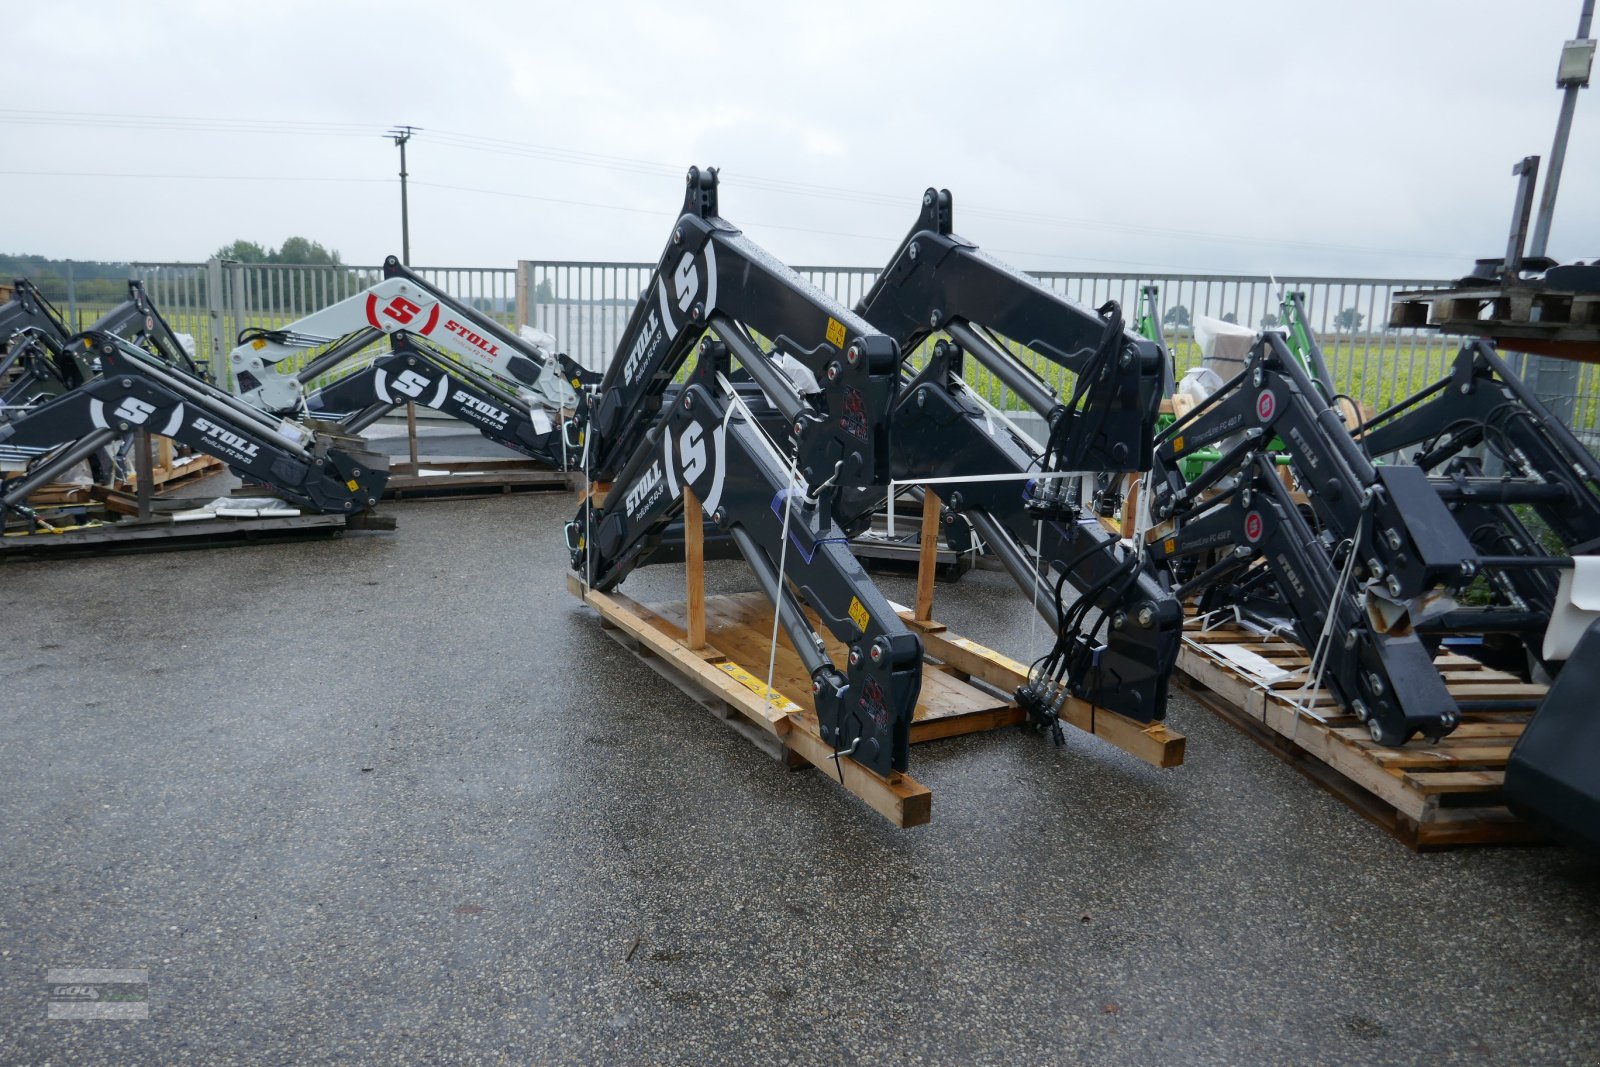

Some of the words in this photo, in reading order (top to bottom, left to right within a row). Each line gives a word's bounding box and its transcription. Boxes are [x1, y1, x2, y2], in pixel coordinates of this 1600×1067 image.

[444, 319, 499, 357] STOLL
[624, 309, 659, 387] STOLL
[452, 389, 510, 425] STOLL
[460, 406, 482, 420] ProfiLine
[481, 416, 490, 424] FZ
[191, 417, 260, 458] STOLL
[201, 436, 226, 451] ProfiLine
[225, 448, 236, 456] FZ
[1289, 427, 1319, 468] STOLL
[625, 459, 662, 518] STOLL
[1276, 553, 1305, 598] STOLL
